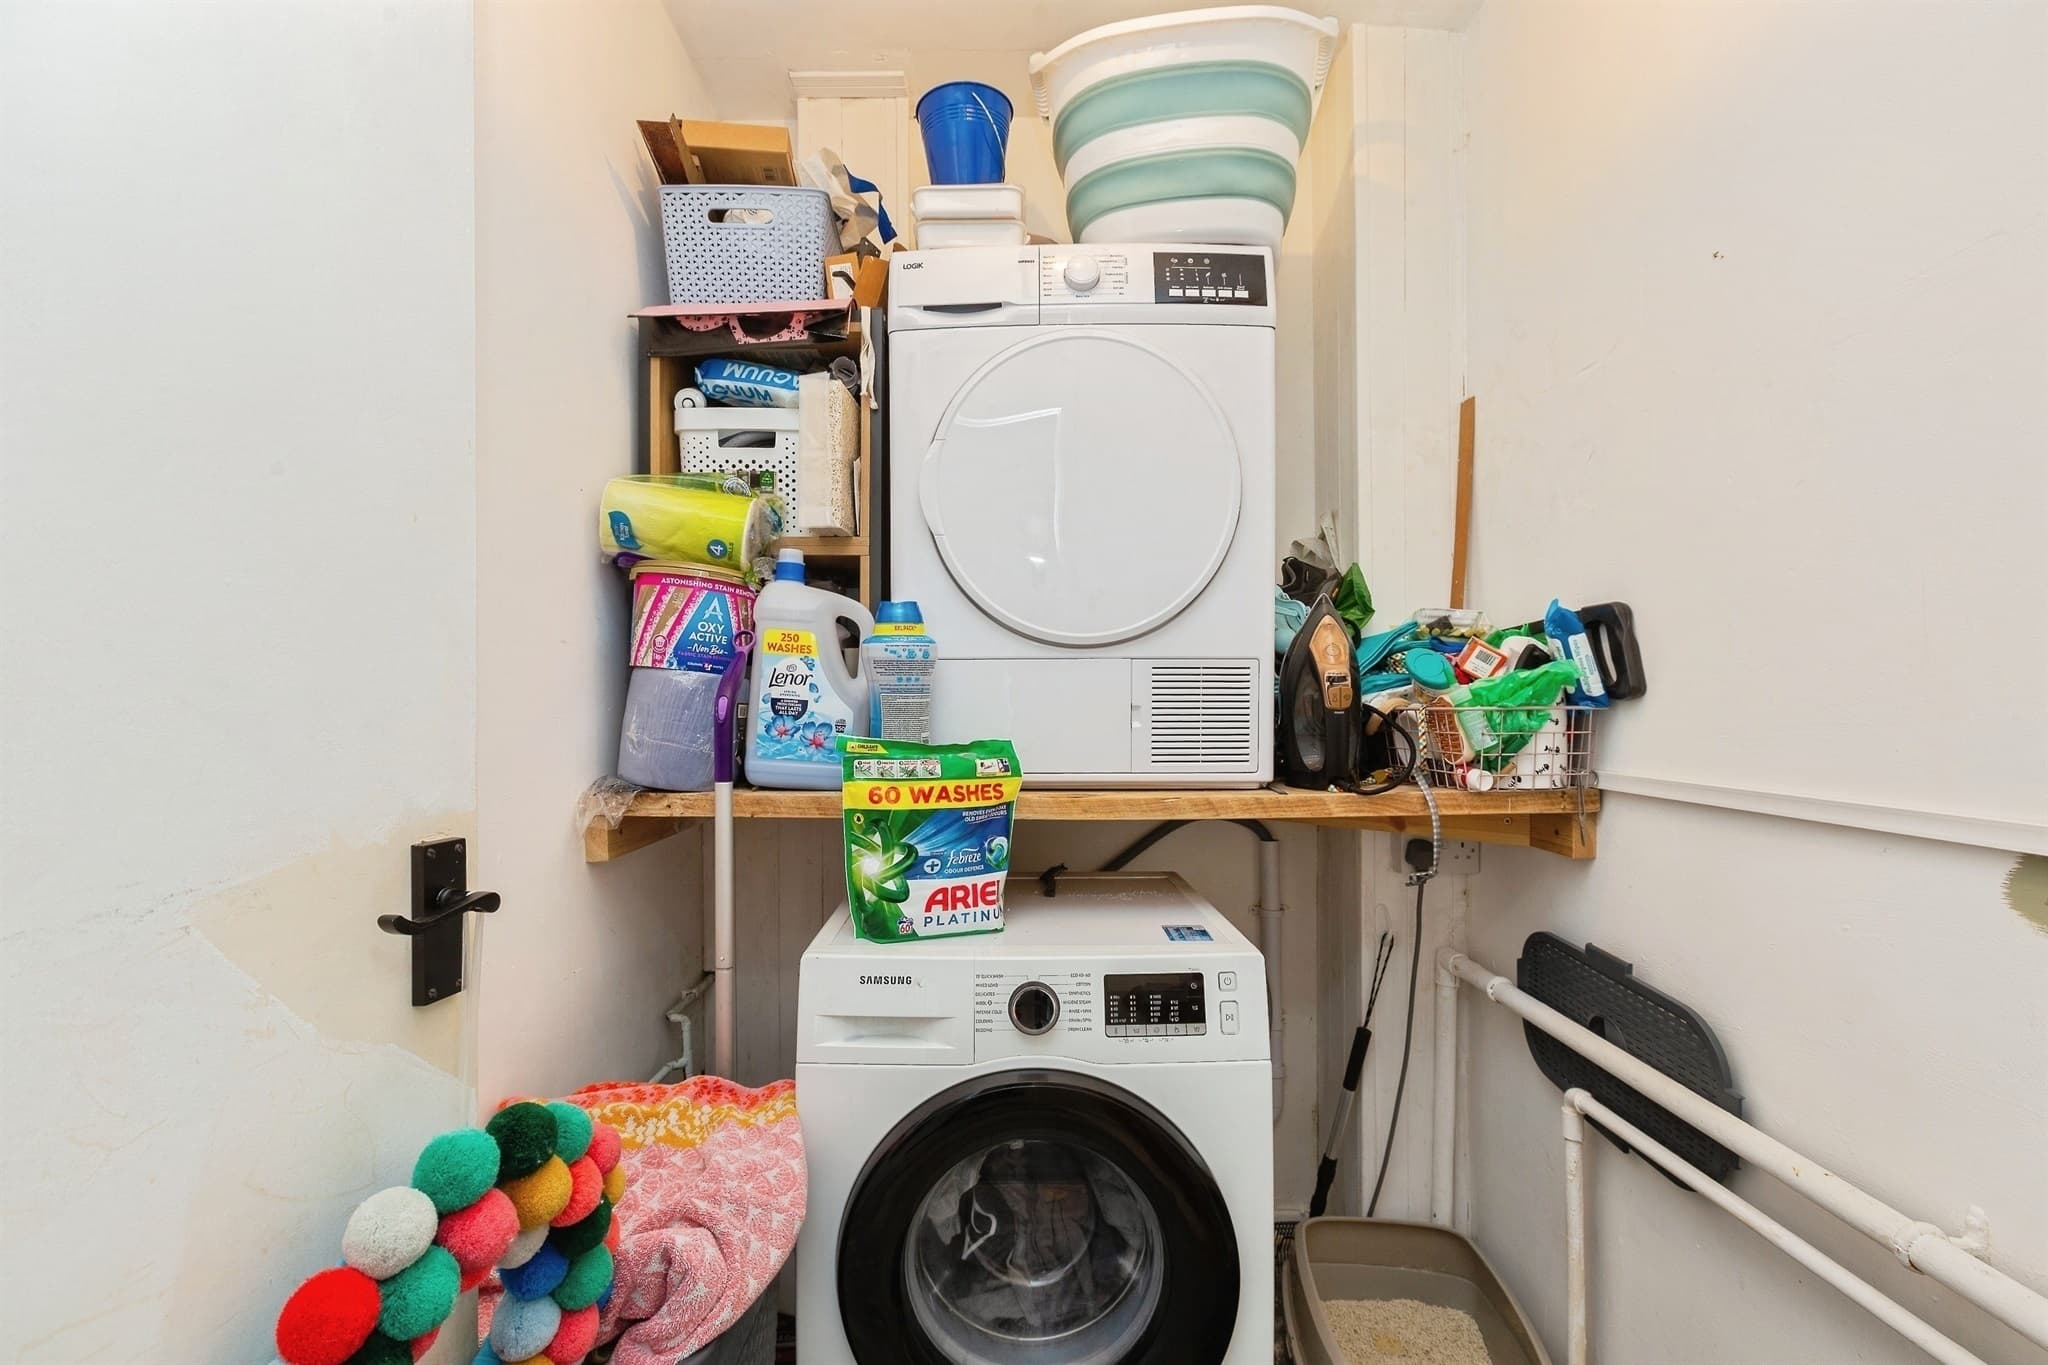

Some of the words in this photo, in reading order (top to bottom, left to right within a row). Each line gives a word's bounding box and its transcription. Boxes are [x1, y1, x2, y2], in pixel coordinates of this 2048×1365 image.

[903, 262, 924, 270] LOGIK
[710, 543, 723, 556] 4
[661, 578, 713, 589] ASTONISHING
[715, 584, 735, 593] STAIN
[735, 588, 755, 599] REMO
[698, 621, 725, 634] OXY
[688, 631, 728, 645] ACTIVE
[780, 633, 800, 643] 250
[767, 642, 813, 655] WASHES
[768, 667, 813, 688] Lenor
[868, 786, 901, 804] 60
[909, 783, 1004, 804] WASHES
[946, 849, 981, 867] febreze
[964, 865, 984, 873] DEFENCE
[924, 908, 1001, 927] PLATINU
[900, 924, 910, 933] 60
[859, 976, 912, 984] SAMSUNG
